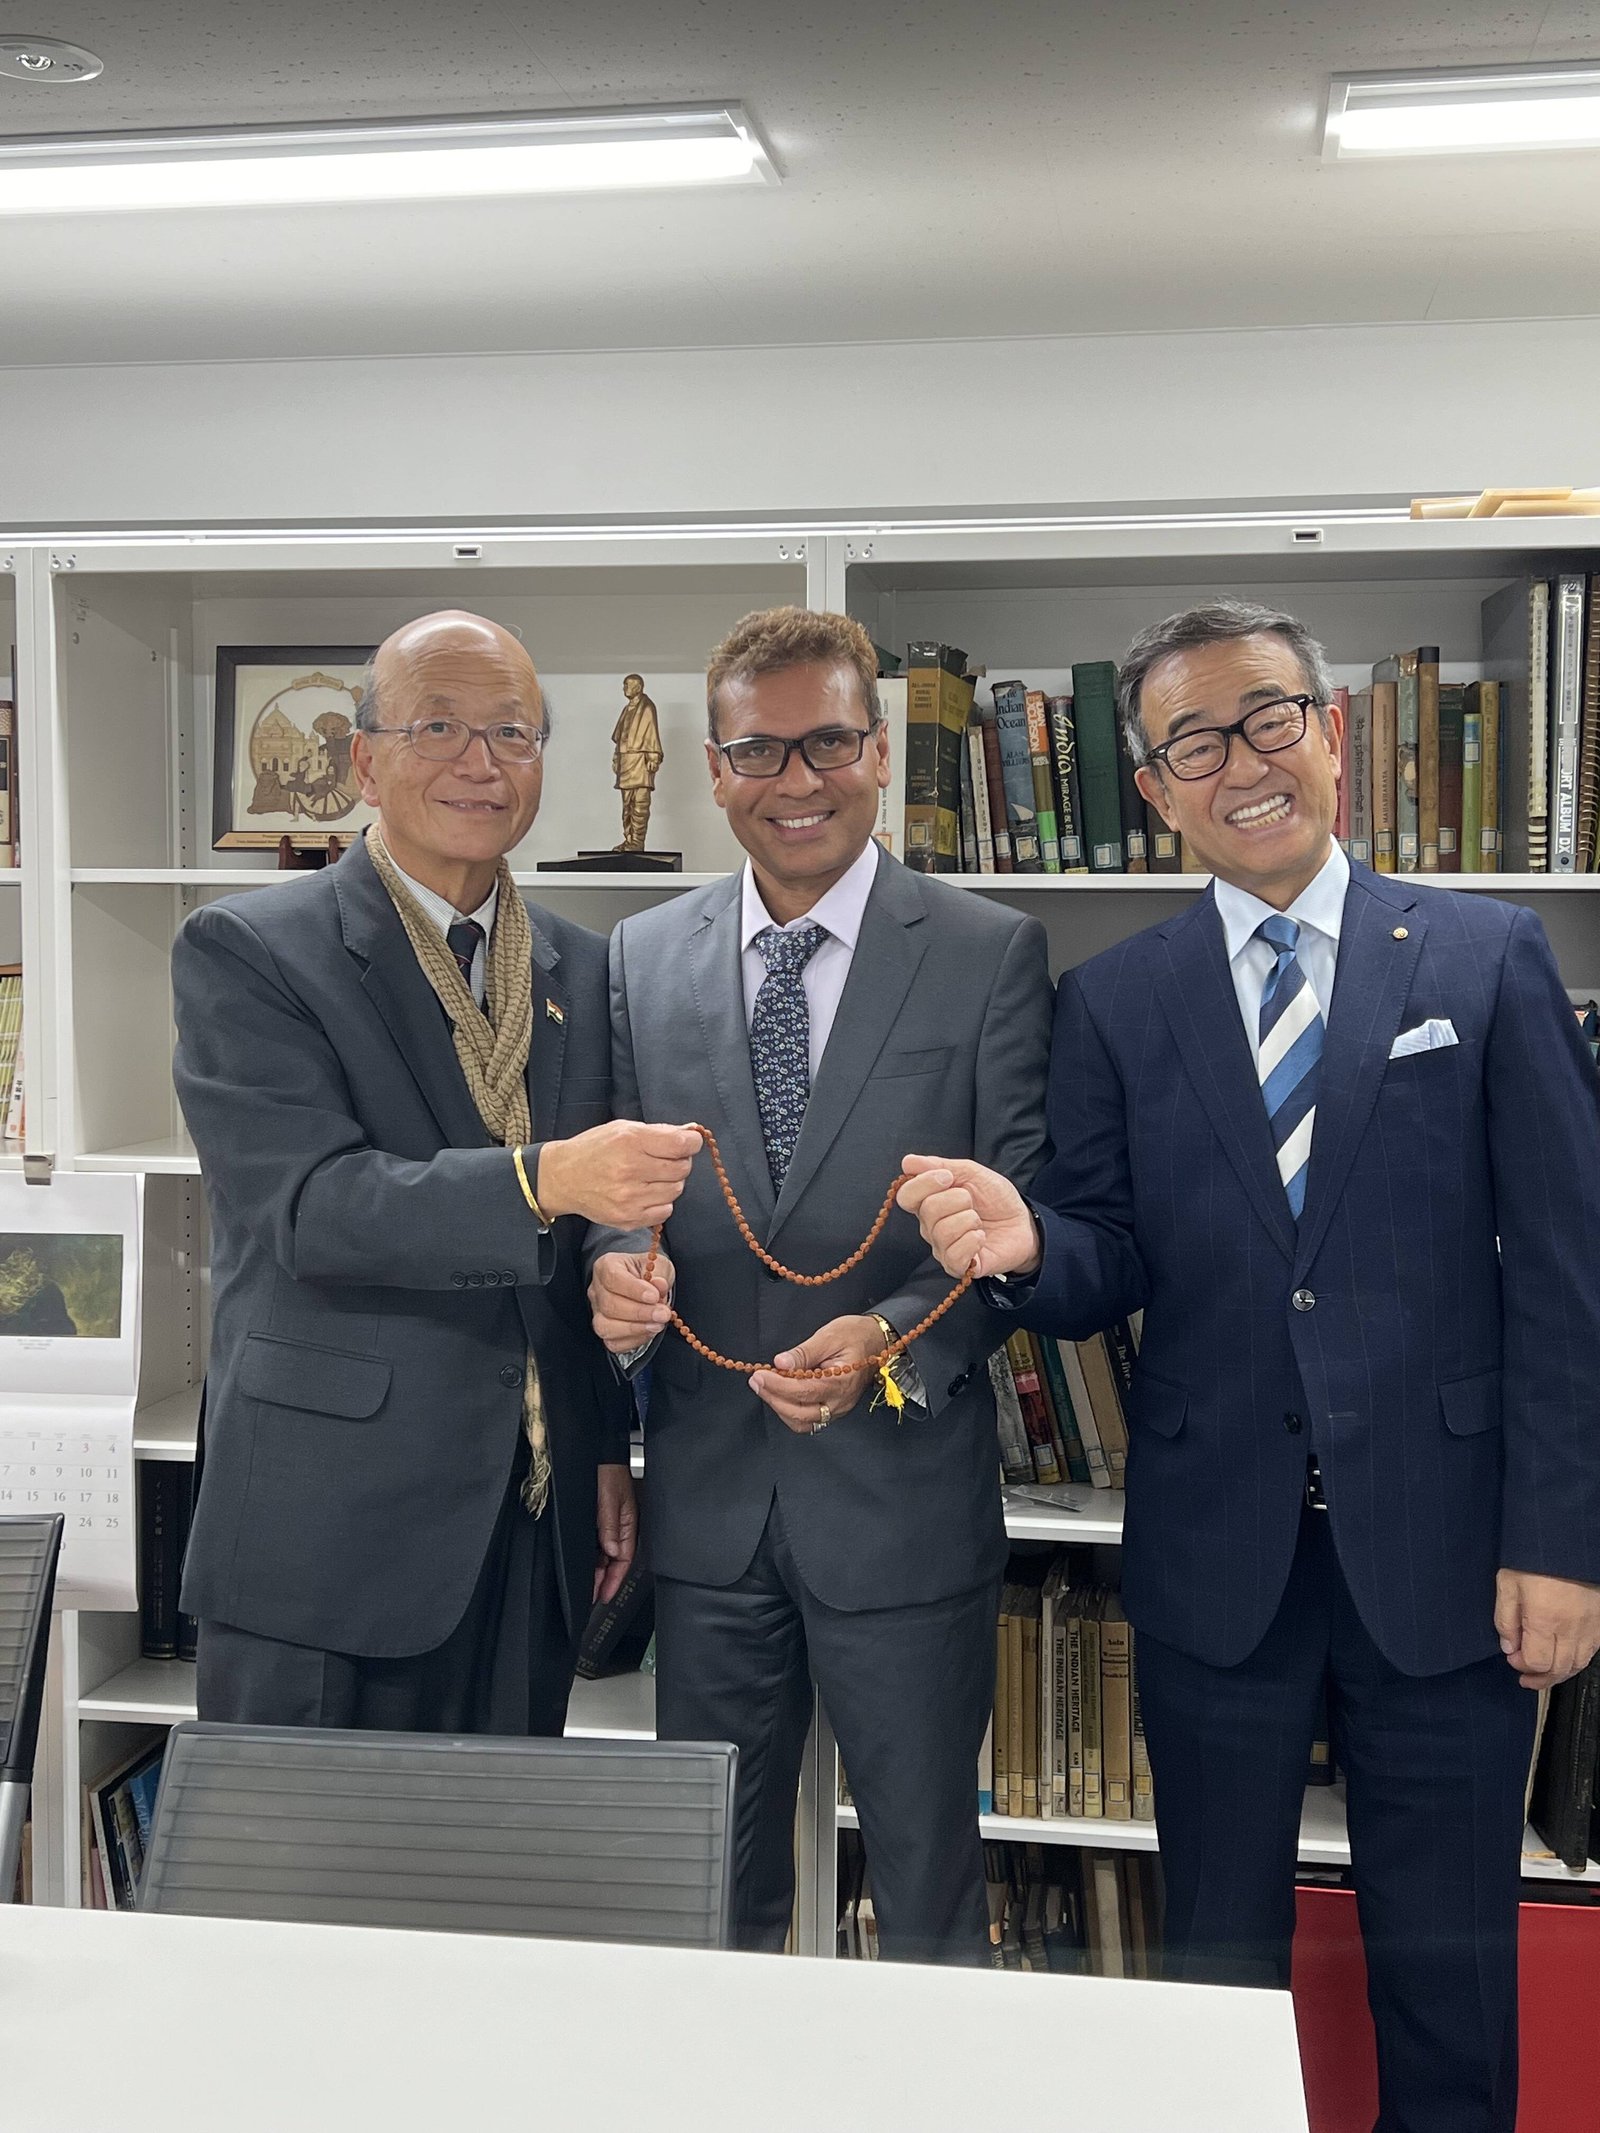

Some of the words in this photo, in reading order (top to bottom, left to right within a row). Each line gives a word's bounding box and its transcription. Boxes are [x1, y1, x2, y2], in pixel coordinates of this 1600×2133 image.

[996, 699, 1024, 714] Indian
[997, 717, 1026, 730] Ocean
[1026, 696, 1040, 752] EXCURSION
[1053, 714, 1076, 775] India
[1060, 778, 1072, 813] MIRAGE
[1560, 792, 1572, 832] ALBUM
[1558, 837, 1571, 854] DX
[80, 1468, 92, 1478] 10
[106, 1469, 118, 1478] 11
[0, 1491, 12, 1501] 14
[27, 1492, 38, 1502] 15
[54, 1492, 66, 1502] 16
[80, 1493, 92, 1503] 17
[106, 1494, 118, 1504] 18
[79, 1518, 92, 1528] 24
[106, 1518, 118, 1528] 25
[1056, 1638, 1064, 1655] THE
[1070, 1632, 1078, 1648] THE
[1056, 1658, 1064, 1692] INDIAN
[1071, 1651, 1080, 1686] INDIAN
[1056, 1697, 1064, 1740] HERITAGE
[1072, 1688, 1080, 1733] HERITAGE
